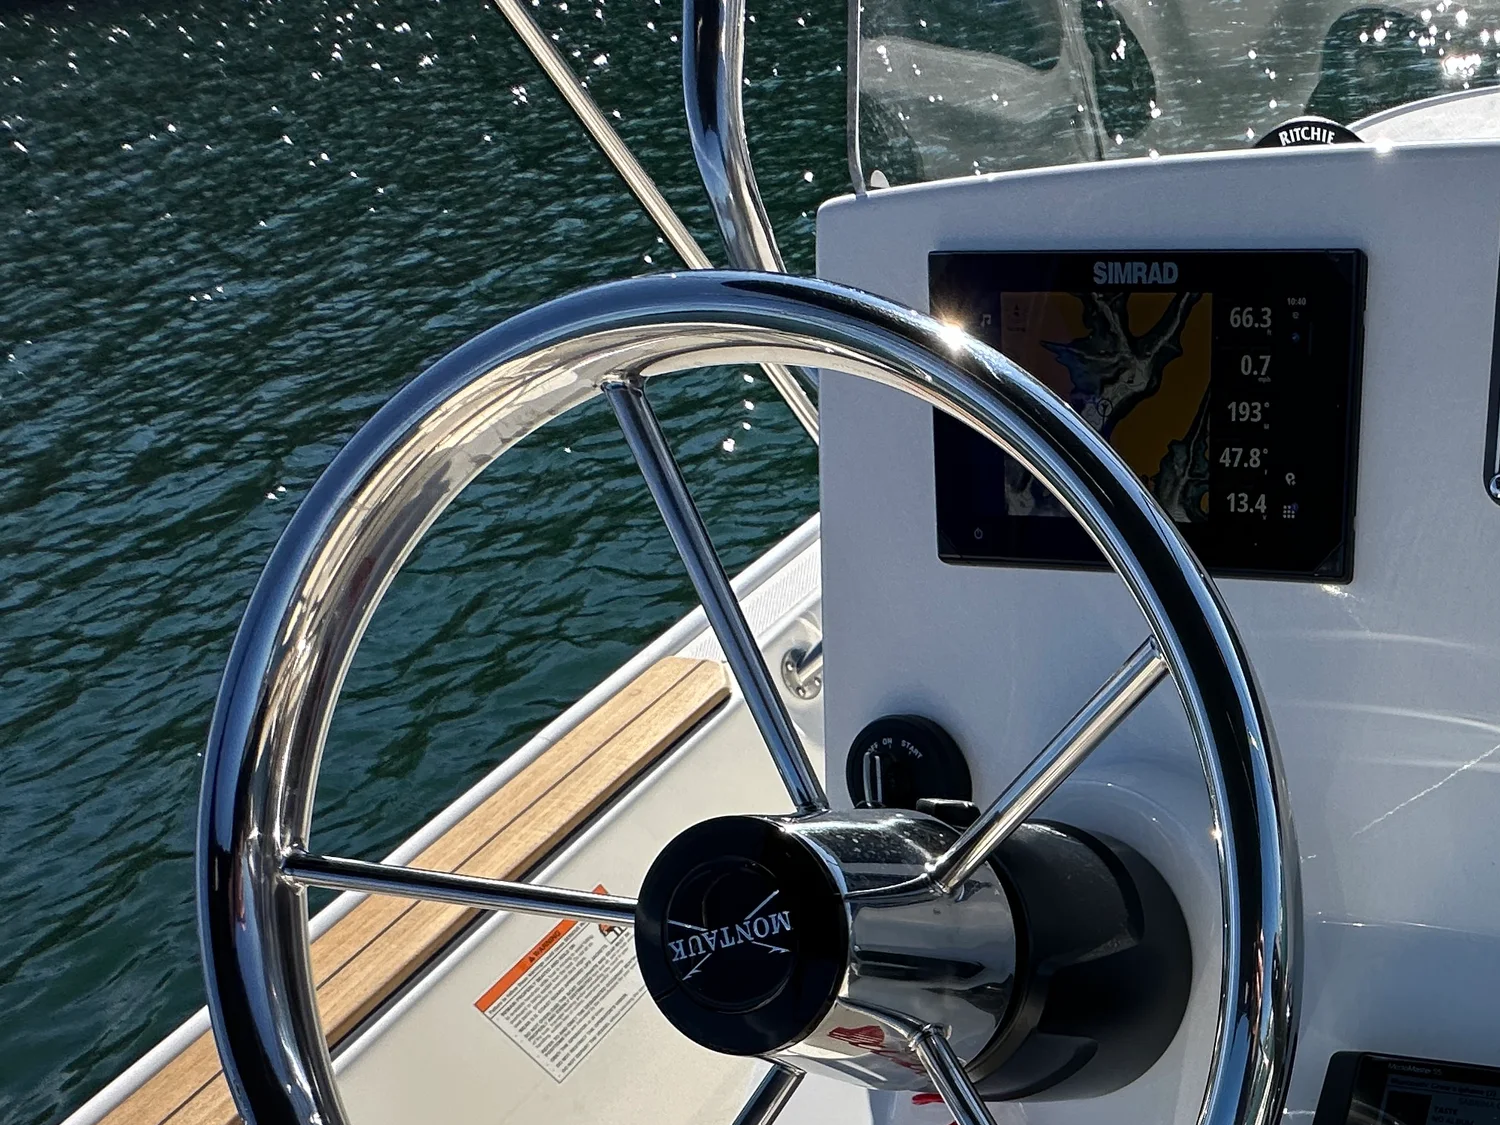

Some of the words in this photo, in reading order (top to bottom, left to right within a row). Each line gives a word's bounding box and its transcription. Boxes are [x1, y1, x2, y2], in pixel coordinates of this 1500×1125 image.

[1278, 126, 1335, 146] RITCHIE
[1093, 262, 1178, 285] SIMRAD
[1287, 297, 1307, 307] 10:40
[1229, 306, 1272, 329] 66.3
[1240, 354, 1271, 377] 0.7
[1225, 493, 1268, 515] 13.4
[901, 739, 923, 759] START
[532, 929, 561, 957] WARNING
[667, 909, 794, 963] MONTAUK
